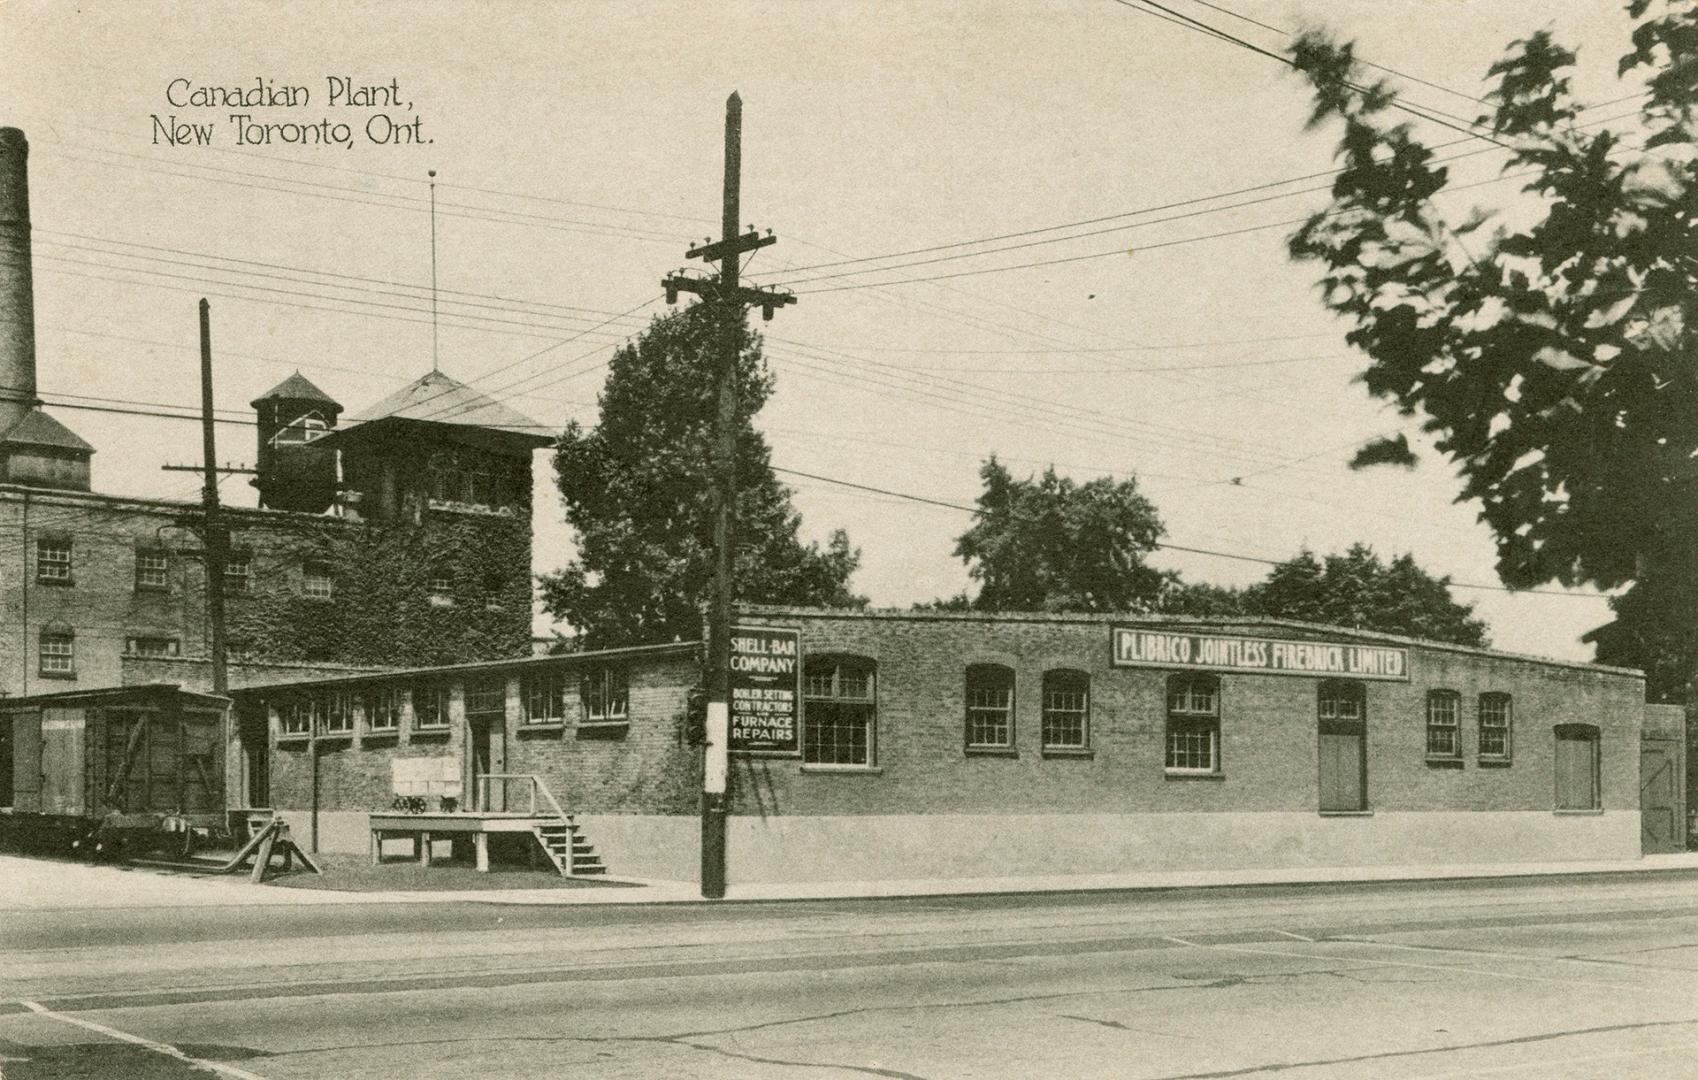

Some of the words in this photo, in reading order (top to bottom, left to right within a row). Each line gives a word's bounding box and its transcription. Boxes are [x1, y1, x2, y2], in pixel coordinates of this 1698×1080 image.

[730, 637, 796, 656] SHELL-BAR
[1121, 632, 1191, 663] PLIBRICO
[1195, 638, 1268, 667] JOINTLESS
[1272, 642, 1344, 672] FIREBRICK
[1349, 647, 1402, 675] LIMITED
[730, 655, 796, 673] COMPANY
[733, 715, 793, 729] FURNACE
[733, 727, 793, 741] REPAIRS
